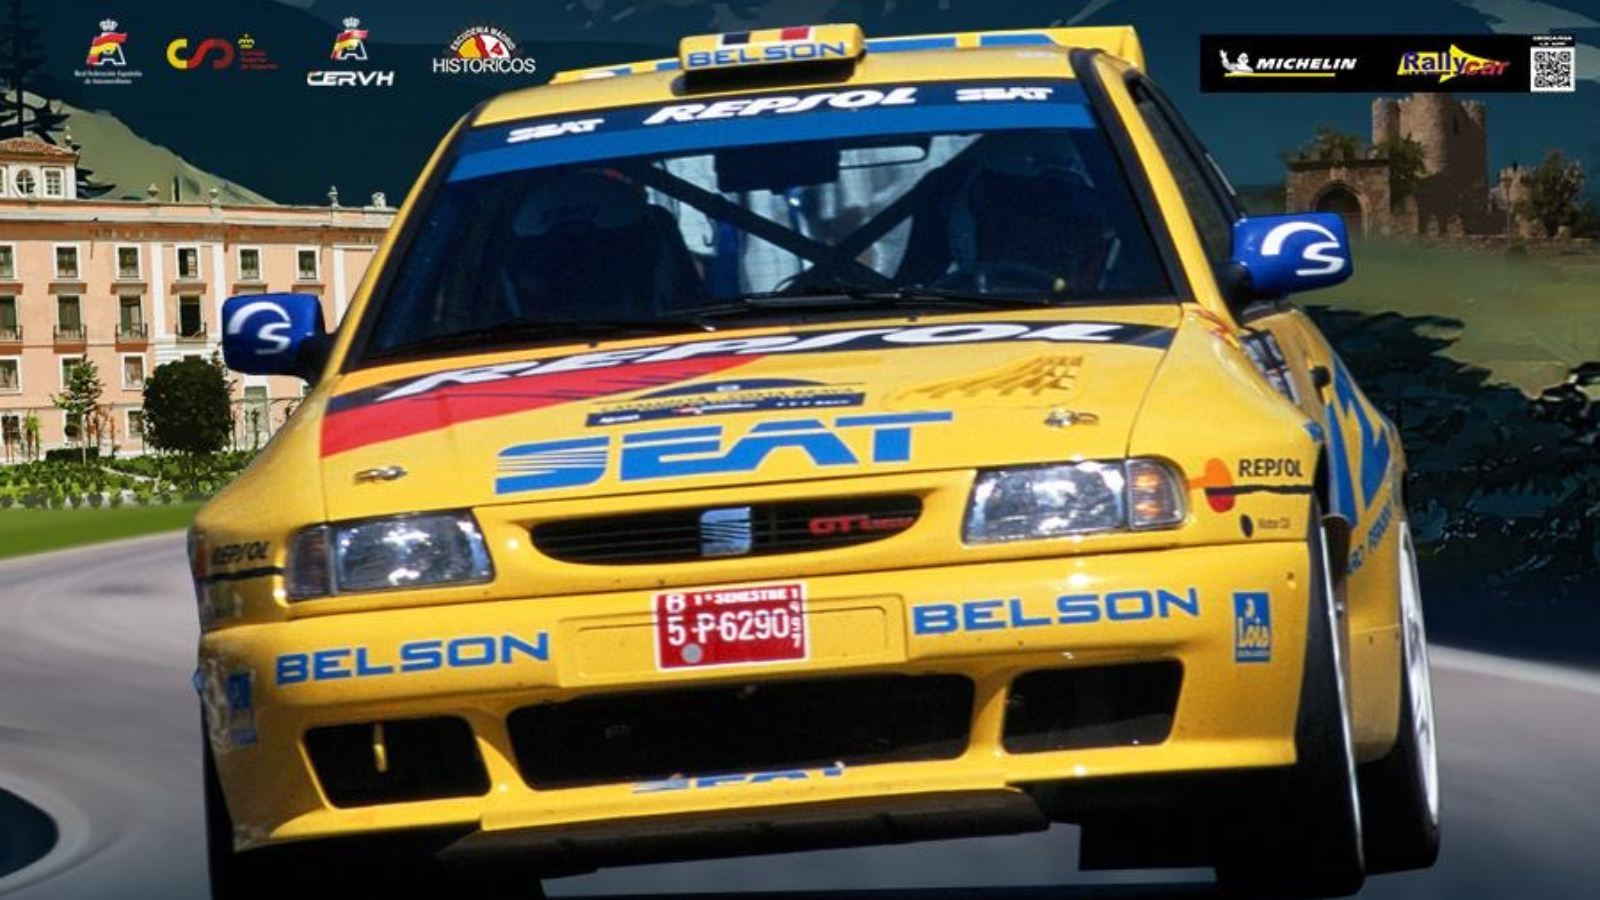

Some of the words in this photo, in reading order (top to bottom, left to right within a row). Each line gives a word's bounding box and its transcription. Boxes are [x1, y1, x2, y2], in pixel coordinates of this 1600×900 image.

[688, 41, 847, 67] BELSON
[642, 86, 918, 125] REPSOL
[955, 86, 1054, 102] SEAT
[507, 118, 605, 143] SEAT
[376, 322, 1124, 402] REPSOL
[494, 411, 953, 494] SEAT
[1238, 458, 1304, 478] REPSOL
[665, 593, 687, 613] B
[713, 588, 787, 605] SEMESTRE
[912, 587, 1199, 636] BELSON
[275, 632, 550, 686] BELSON
